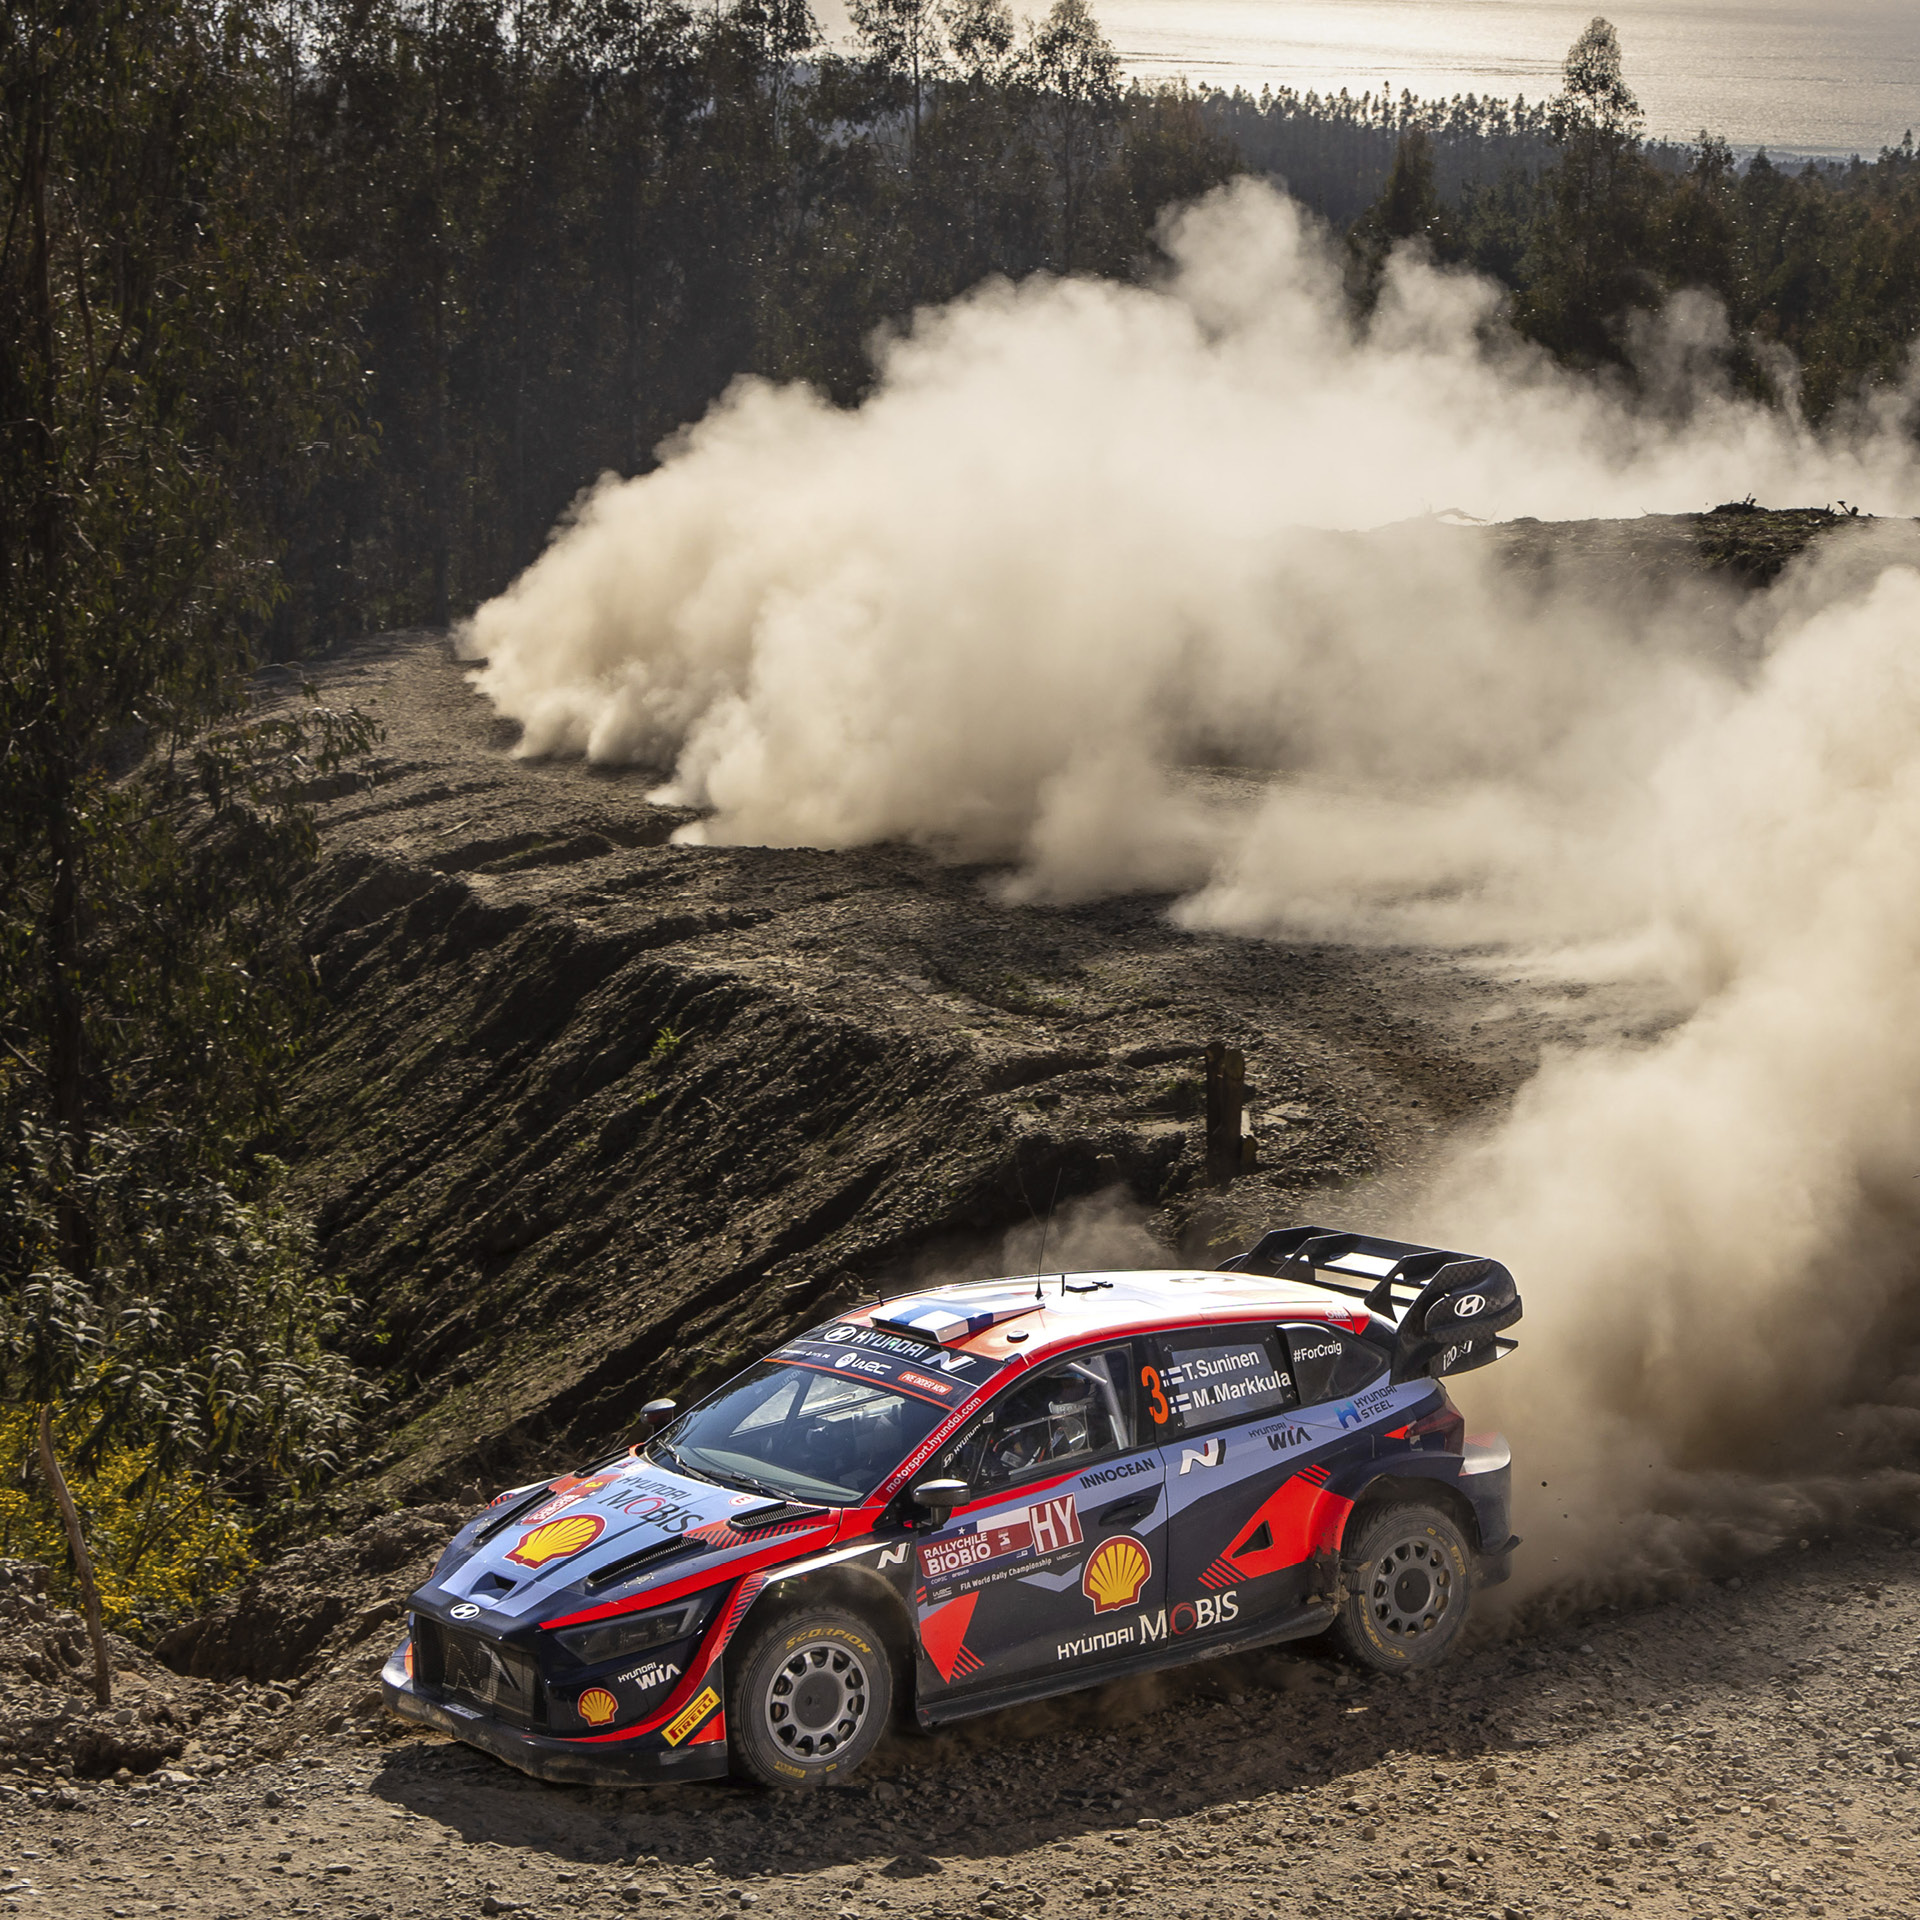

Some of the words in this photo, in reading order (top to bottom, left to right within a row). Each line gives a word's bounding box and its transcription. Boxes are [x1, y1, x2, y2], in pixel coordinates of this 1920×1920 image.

[851, 1331, 930, 1358] HYUNDAI
[1293, 1340, 1342, 1363] #ForCraig
[851, 1357, 892, 1375] WRC
[1181, 1351, 1260, 1381] T.Suninen
[902, 1373, 916, 1383] PRE
[914, 1376, 935, 1389] ORDER
[932, 1382, 949, 1394] NOW
[1141, 1365, 1169, 1424] 3
[1192, 1370, 1292, 1408] M.Markkula
[1354, 1385, 1398, 1408] HYUNDAI
[1360, 1399, 1394, 1419] STEEL
[953, 1423, 981, 1455] HYUND
[1248, 1422, 1287, 1438] HYUNDAI
[885, 1397, 982, 1493] motorsport.hyundai.com
[616, 1475, 693, 1501] HYUNDAI
[1079, 1458, 1156, 1489] INNOCEAN
[597, 1488, 705, 1534] MOBIS
[1031, 1496, 1074, 1553] HY
[923, 1532, 988, 1560] RALLYCHILE
[960, 1580, 971, 1591] FIA
[972, 1575, 991, 1588] World
[991, 1572, 1008, 1584] Rally
[1008, 1558, 1053, 1577] Championship
[1057, 1626, 1135, 1660] HYUNDAI
[1138, 1590, 1240, 1646] MOBIS
[785, 1628, 873, 1655] SCORPION
[617, 1662, 657, 1683] HYUNDAI
[668, 1693, 714, 1741] PIRELLI
